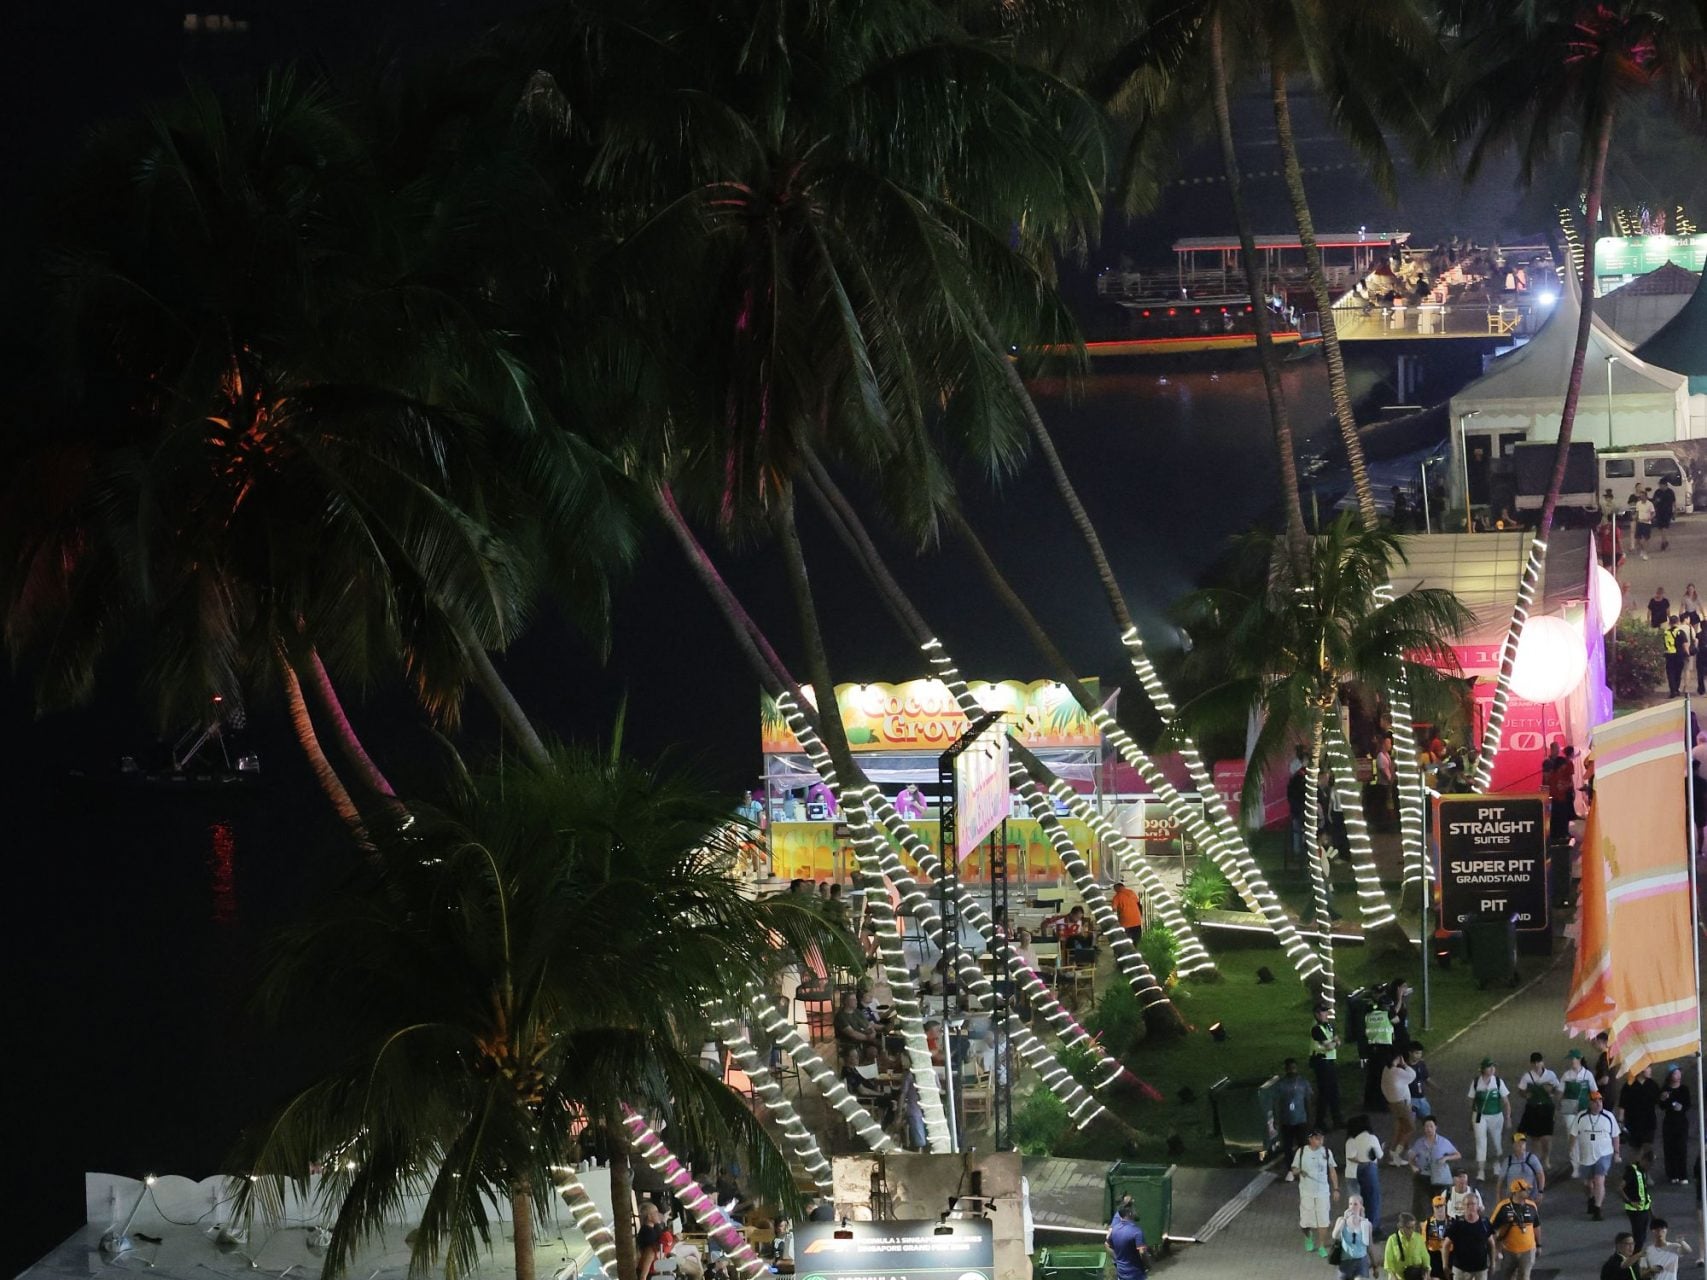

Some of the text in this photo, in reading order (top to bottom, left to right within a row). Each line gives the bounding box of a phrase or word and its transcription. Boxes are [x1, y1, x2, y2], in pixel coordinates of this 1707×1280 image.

[863, 696, 963, 719] Cocon
[1504, 719, 1542, 728] JETTY
[1478, 808, 1505, 820] PIT
[1449, 821, 1535, 835] STRAIGHT
[1474, 836, 1511, 845] SUITES
[1451, 860, 1535, 874] SUPER PIT
[1456, 874, 1530, 884] GRANDSTAND
[1480, 900, 1508, 912] PIT
